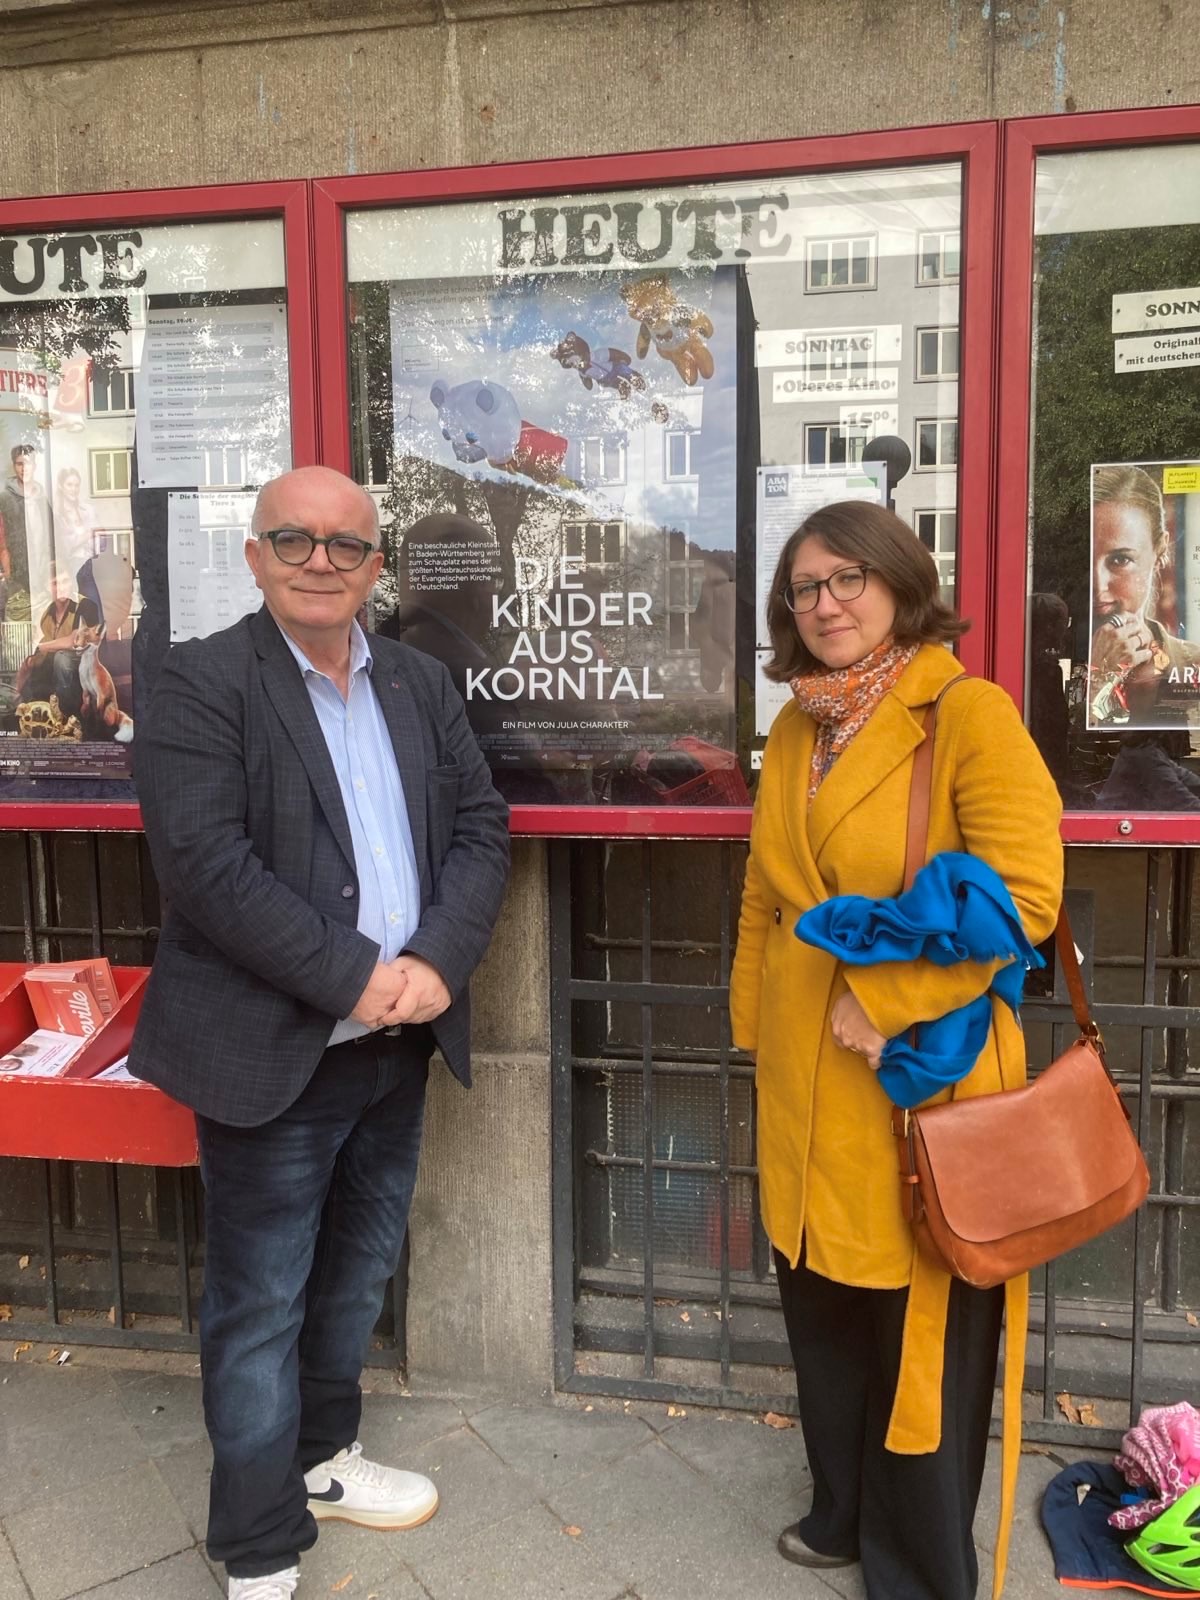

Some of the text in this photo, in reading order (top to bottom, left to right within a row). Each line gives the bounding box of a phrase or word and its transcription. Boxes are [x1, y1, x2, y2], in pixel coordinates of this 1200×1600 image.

[498, 193, 792, 268] HEUTE
[0, 231, 147, 295] UTE
[785, 337, 872, 354] SONNTAG
[1126, 356, 1144, 365] mit
[783, 377, 891, 393] Oberes Kino
[767, 477, 787, 485] ABA
[767, 485, 787, 493] TON
[424, 541, 466, 549] beschauliche
[416, 550, 484, 558] Baden-Württemberg
[424, 558, 460, 567] Schauplatz
[408, 566, 502, 576] größten Missbrauchsskandale
[515, 555, 584, 590] DIE
[421, 574, 468, 583] Evangelischen
[492, 592, 653, 628] KINDER
[508, 630, 594, 664] AUS
[466, 659, 664, 700] KORNTAL
[502, 721, 628, 729] EIN FILM VON JULIA CHARAKTER
